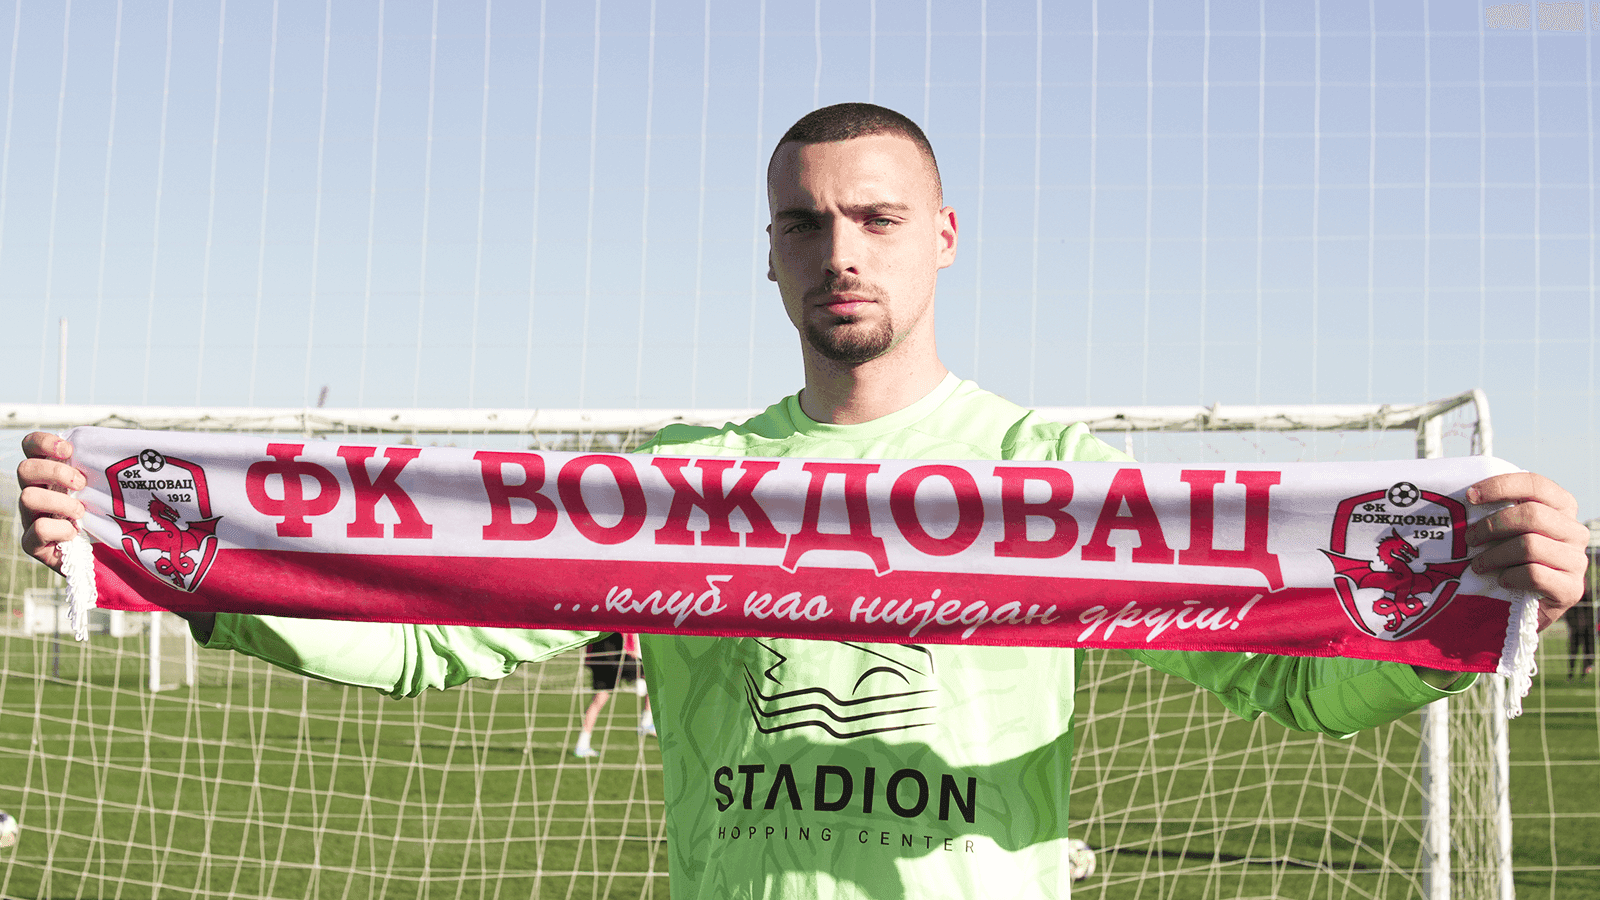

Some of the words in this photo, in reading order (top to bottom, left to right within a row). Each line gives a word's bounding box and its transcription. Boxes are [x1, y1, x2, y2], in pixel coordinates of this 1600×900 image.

[123, 469, 142, 479] ФК
[119, 479, 194, 491] ВОЖДОВАЦ
[167, 493, 192, 503] 1912
[1362, 503, 1386, 513] ФК
[245, 442, 433, 540] ФК
[472, 450, 1285, 592] ВОЖДОВАЦ
[1351, 513, 1450, 528] ВОЖДОВАЦ
[1413, 529, 1445, 540] 1912
[743, 593, 833, 622] као
[850, 588, 1060, 639] нијeдан
[713, 763, 977, 824] STADION
[717, 826, 832, 842] HOPPING
[858, 830, 975, 853] CENTER
